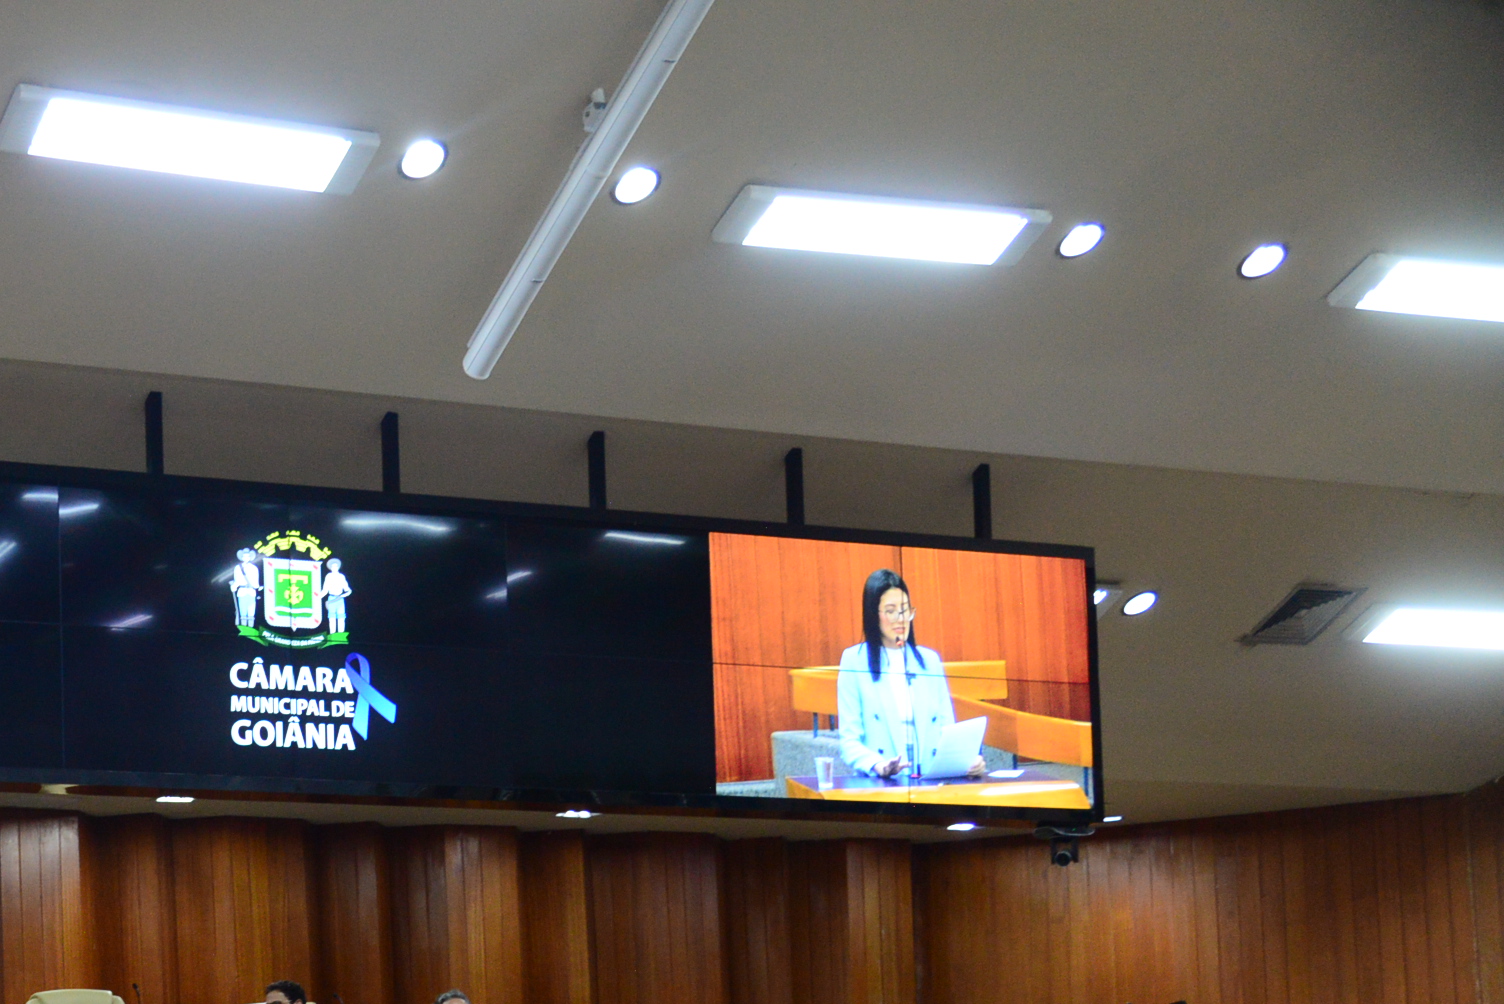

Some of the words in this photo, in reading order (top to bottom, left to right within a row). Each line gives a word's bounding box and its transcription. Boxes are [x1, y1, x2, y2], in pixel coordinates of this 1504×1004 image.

[229, 656, 355, 694] CÂMARA
[230, 694, 330, 717] MUNICIPAL
[331, 700, 356, 718] DE
[230, 715, 356, 751] GOIÂNIA
